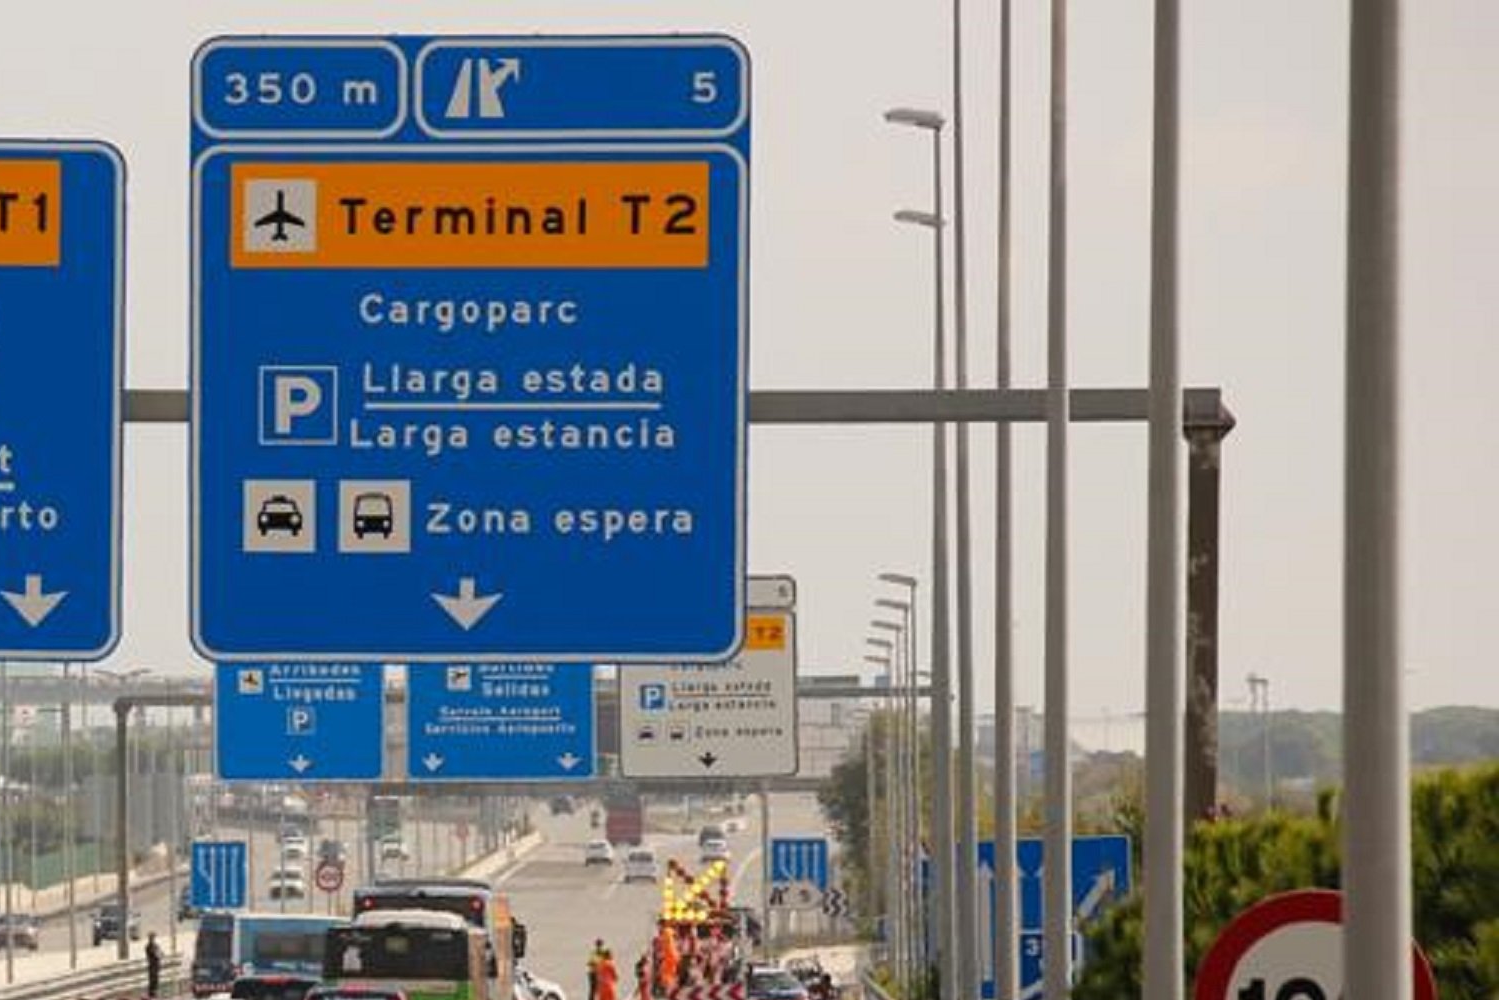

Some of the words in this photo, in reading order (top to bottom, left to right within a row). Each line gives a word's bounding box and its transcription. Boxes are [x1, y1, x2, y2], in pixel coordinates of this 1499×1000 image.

[225, 72, 316, 105] 350
[343, 80, 378, 104] m
[693, 71, 717, 104] 5
[338, 197, 588, 236] Terminal
[620, 193, 697, 236] T2
[359, 293, 576, 332] Cargoparc
[363, 363, 498, 400] Llarga
[523, 364, 663, 393] estada
[274, 375, 322, 434] P
[350, 419, 468, 456] Larga
[493, 420, 675, 448] estancia
[426, 502, 530, 534] Zona
[554, 509, 693, 541] espera
[482, 681, 551, 698] Salidas
[645, 687, 661, 708] P
[292, 710, 309, 732] P
